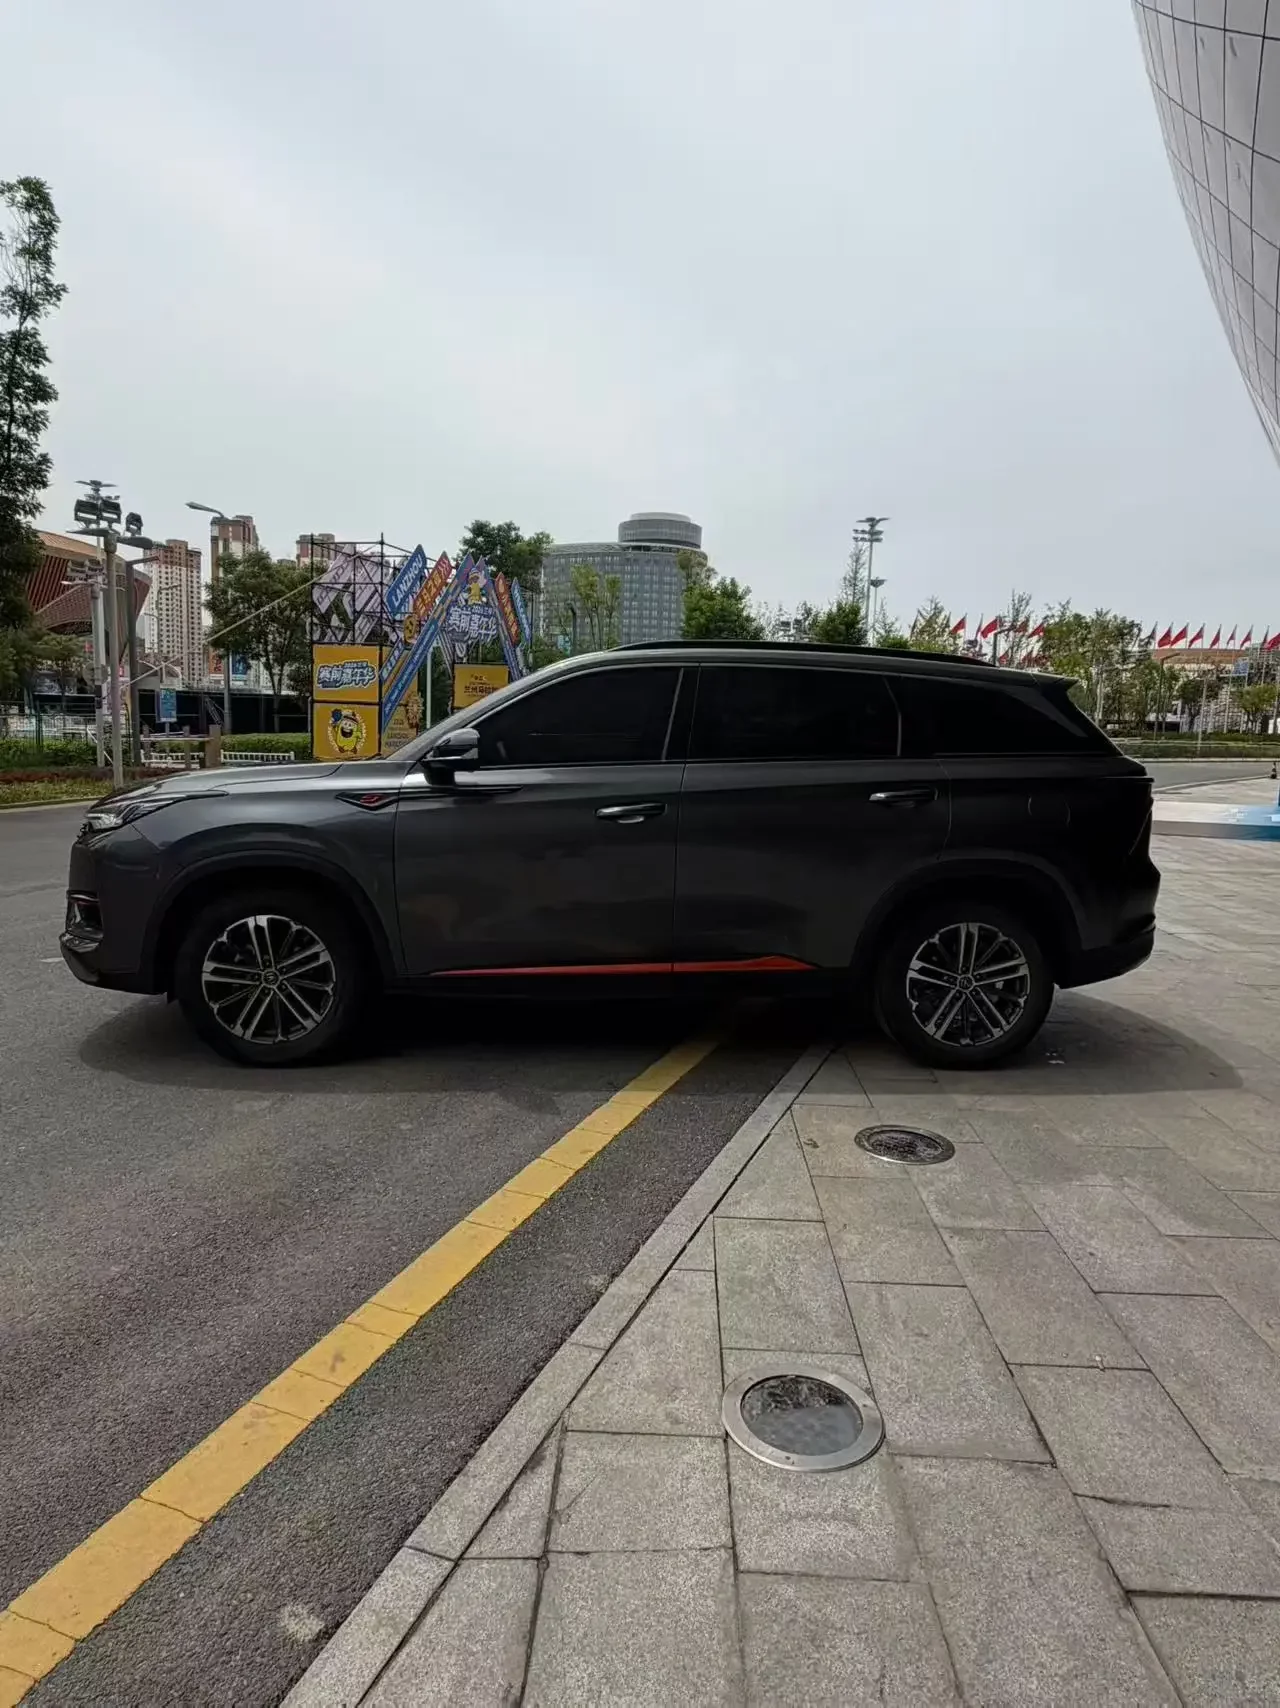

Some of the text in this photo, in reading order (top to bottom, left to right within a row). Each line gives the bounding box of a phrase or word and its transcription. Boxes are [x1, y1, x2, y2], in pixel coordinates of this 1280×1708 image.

[392, 555, 423, 607] LANZHOU
[448, 606, 497, 642] 赛前嘉年华
[318, 666, 375, 687] 赛前嘉年华
